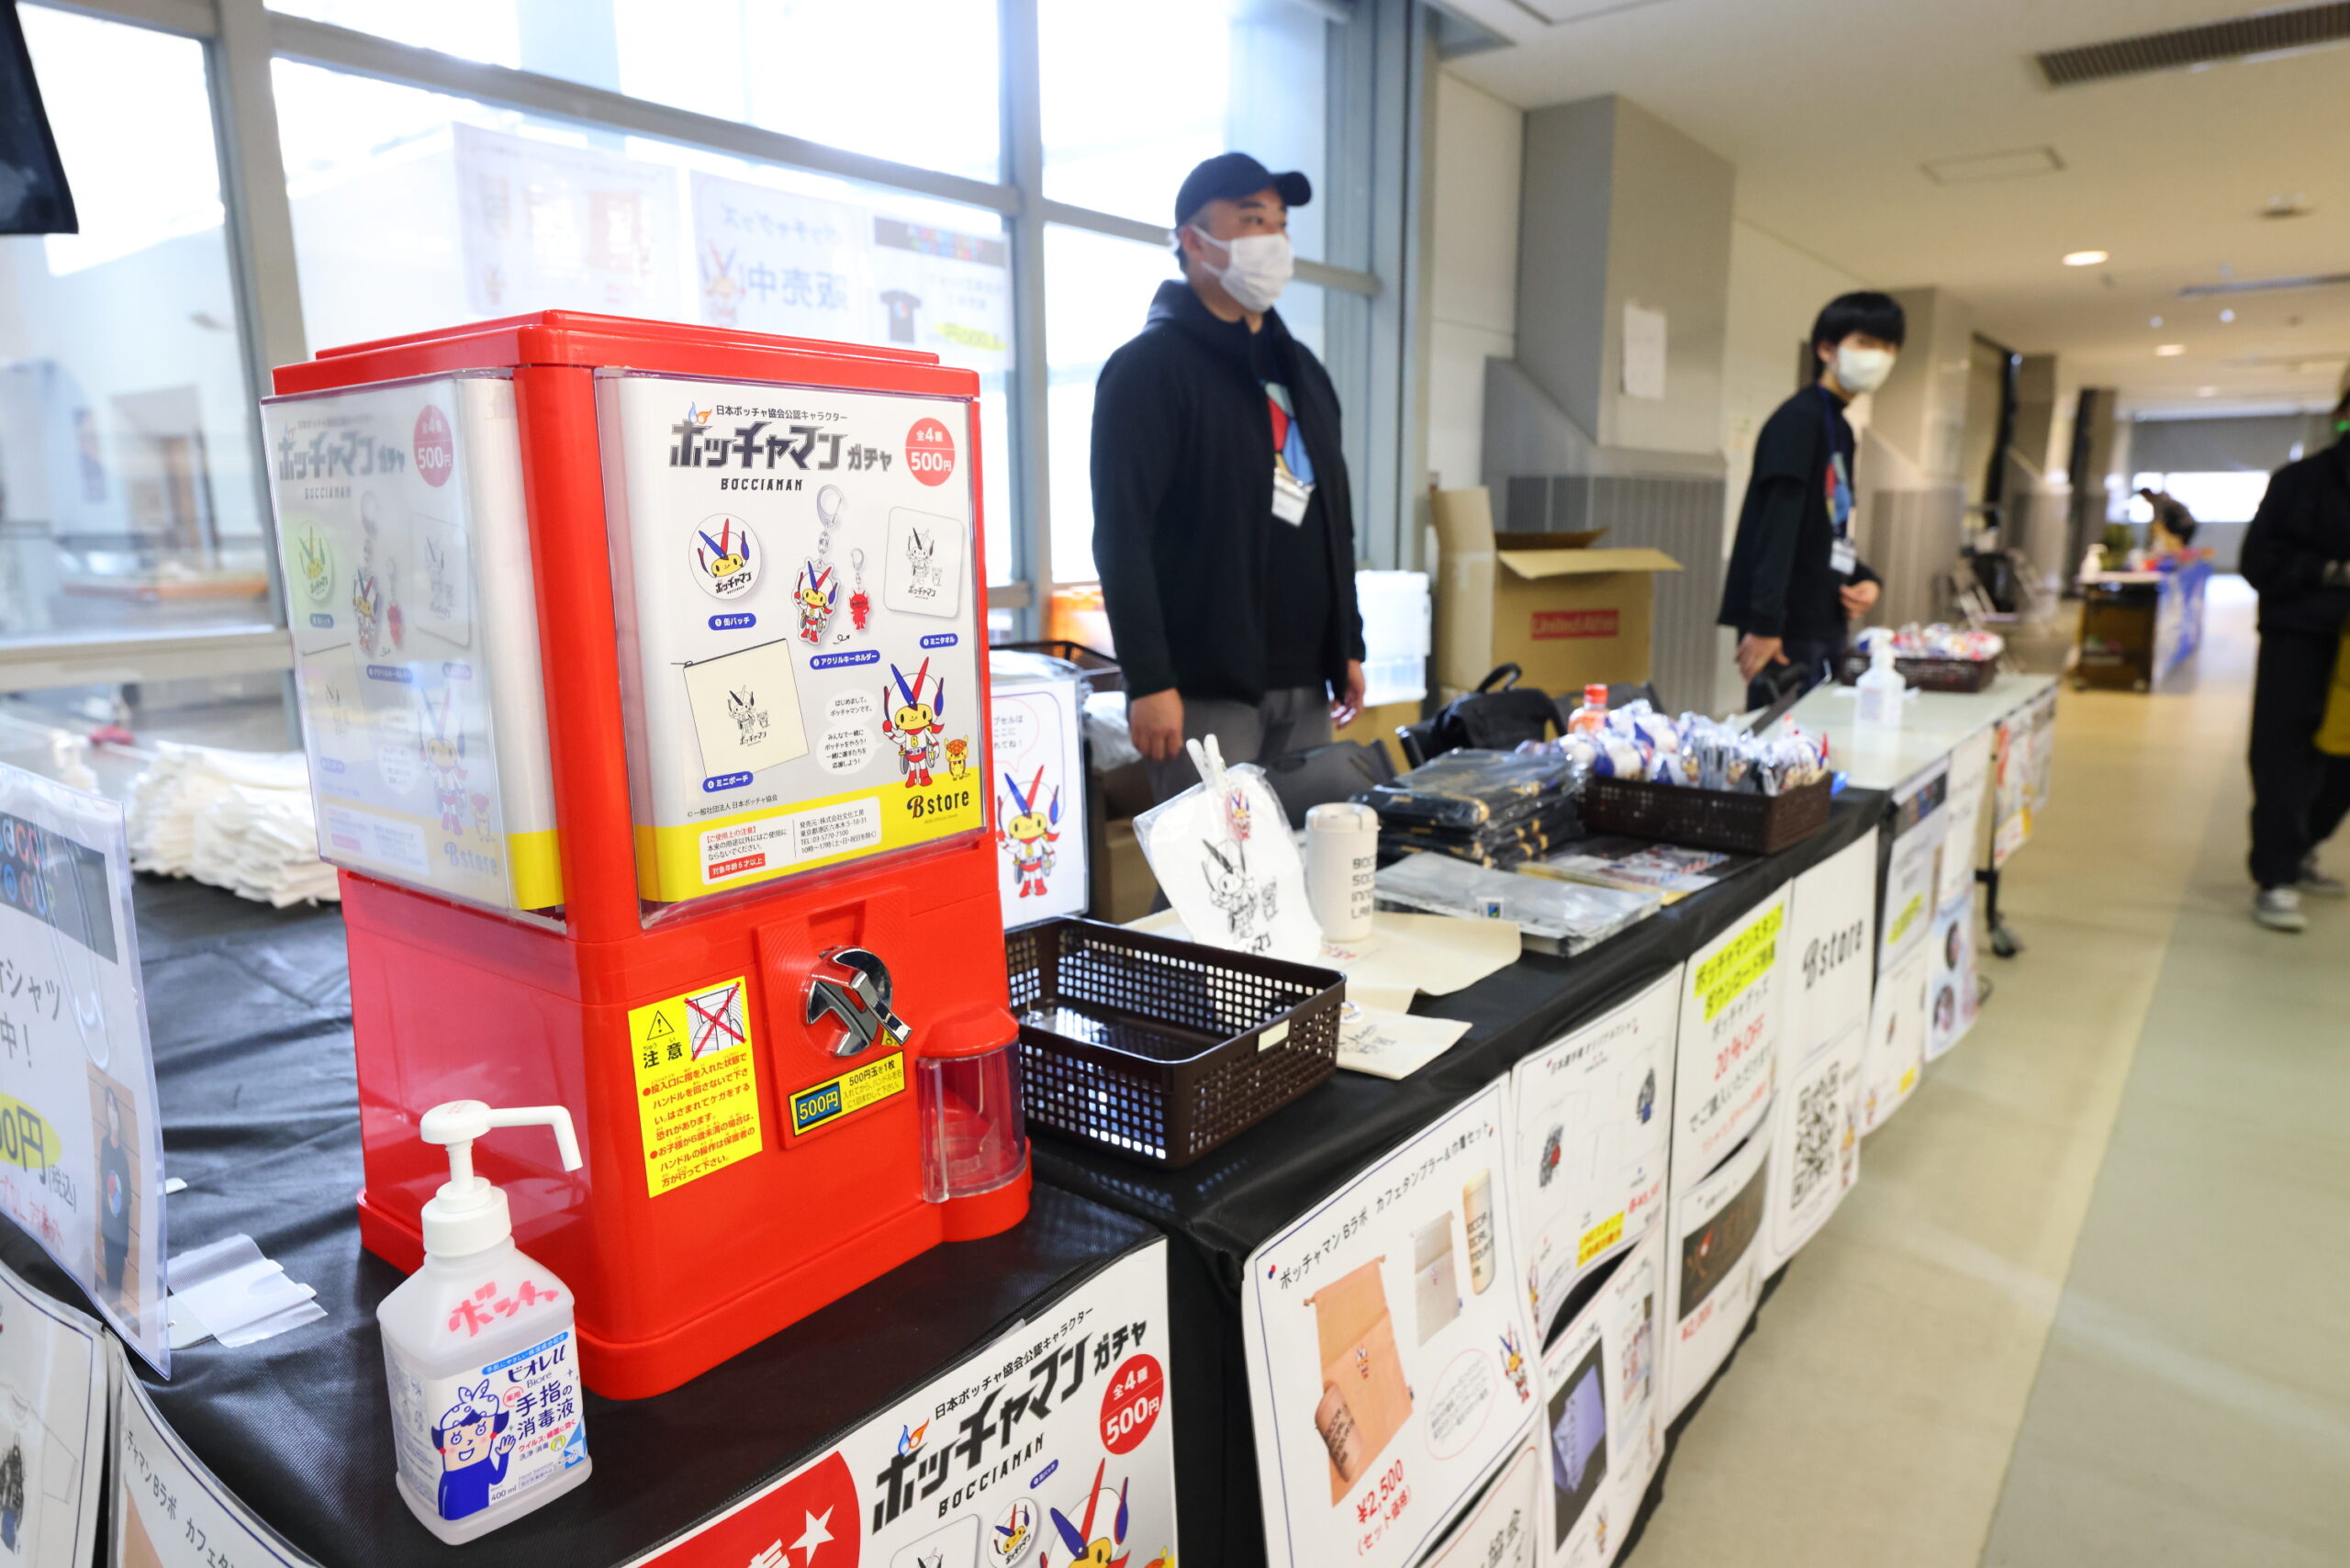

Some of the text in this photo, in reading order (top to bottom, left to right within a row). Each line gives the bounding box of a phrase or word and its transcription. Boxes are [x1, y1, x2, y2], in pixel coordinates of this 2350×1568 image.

[716, 405, 847, 421] 日本ボッチャ協会公認キャラクター
[418, 446, 452, 469] 500円
[669, 419, 892, 472] ボッチャマン ガチャ
[911, 452, 952, 472] 500円
[721, 477, 803, 491] BOCCIAMAN
[821, 653, 878, 666] アクリルキーホルダー
[716, 775, 748, 788] ミニポーチ
[694, 802, 732, 816] 一般社団法人
[733, 794, 778, 809] 日本ボッチャ協会
[643, 1041, 683, 1069] 注意
[653, 1068, 749, 1109] ハンドルを回さないで下さ
[849, 1059, 895, 1086] 500円玉を1枚
[799, 1091, 839, 1121] 500円
[0, 1103, 48, 1186] 0円
[934, 1307, 1093, 1420] 日本ボッチャ協会公認キャラクター
[515, 1380, 573, 1417] 手指の
[1113, 1367, 1149, 1401] 全4種
[517, 1397, 575, 1441] 消毒液
[872, 1320, 1148, 1535] ボッチャマン ガチャ
[1106, 1396, 1160, 1445] 500円
[938, 1433, 1045, 1518] BOCCIAMAN
[1357, 1459, 1404, 1524] ¥2,500
[491, 1489, 507, 1501] 400
[185, 1517, 235, 1568] カフェタ
